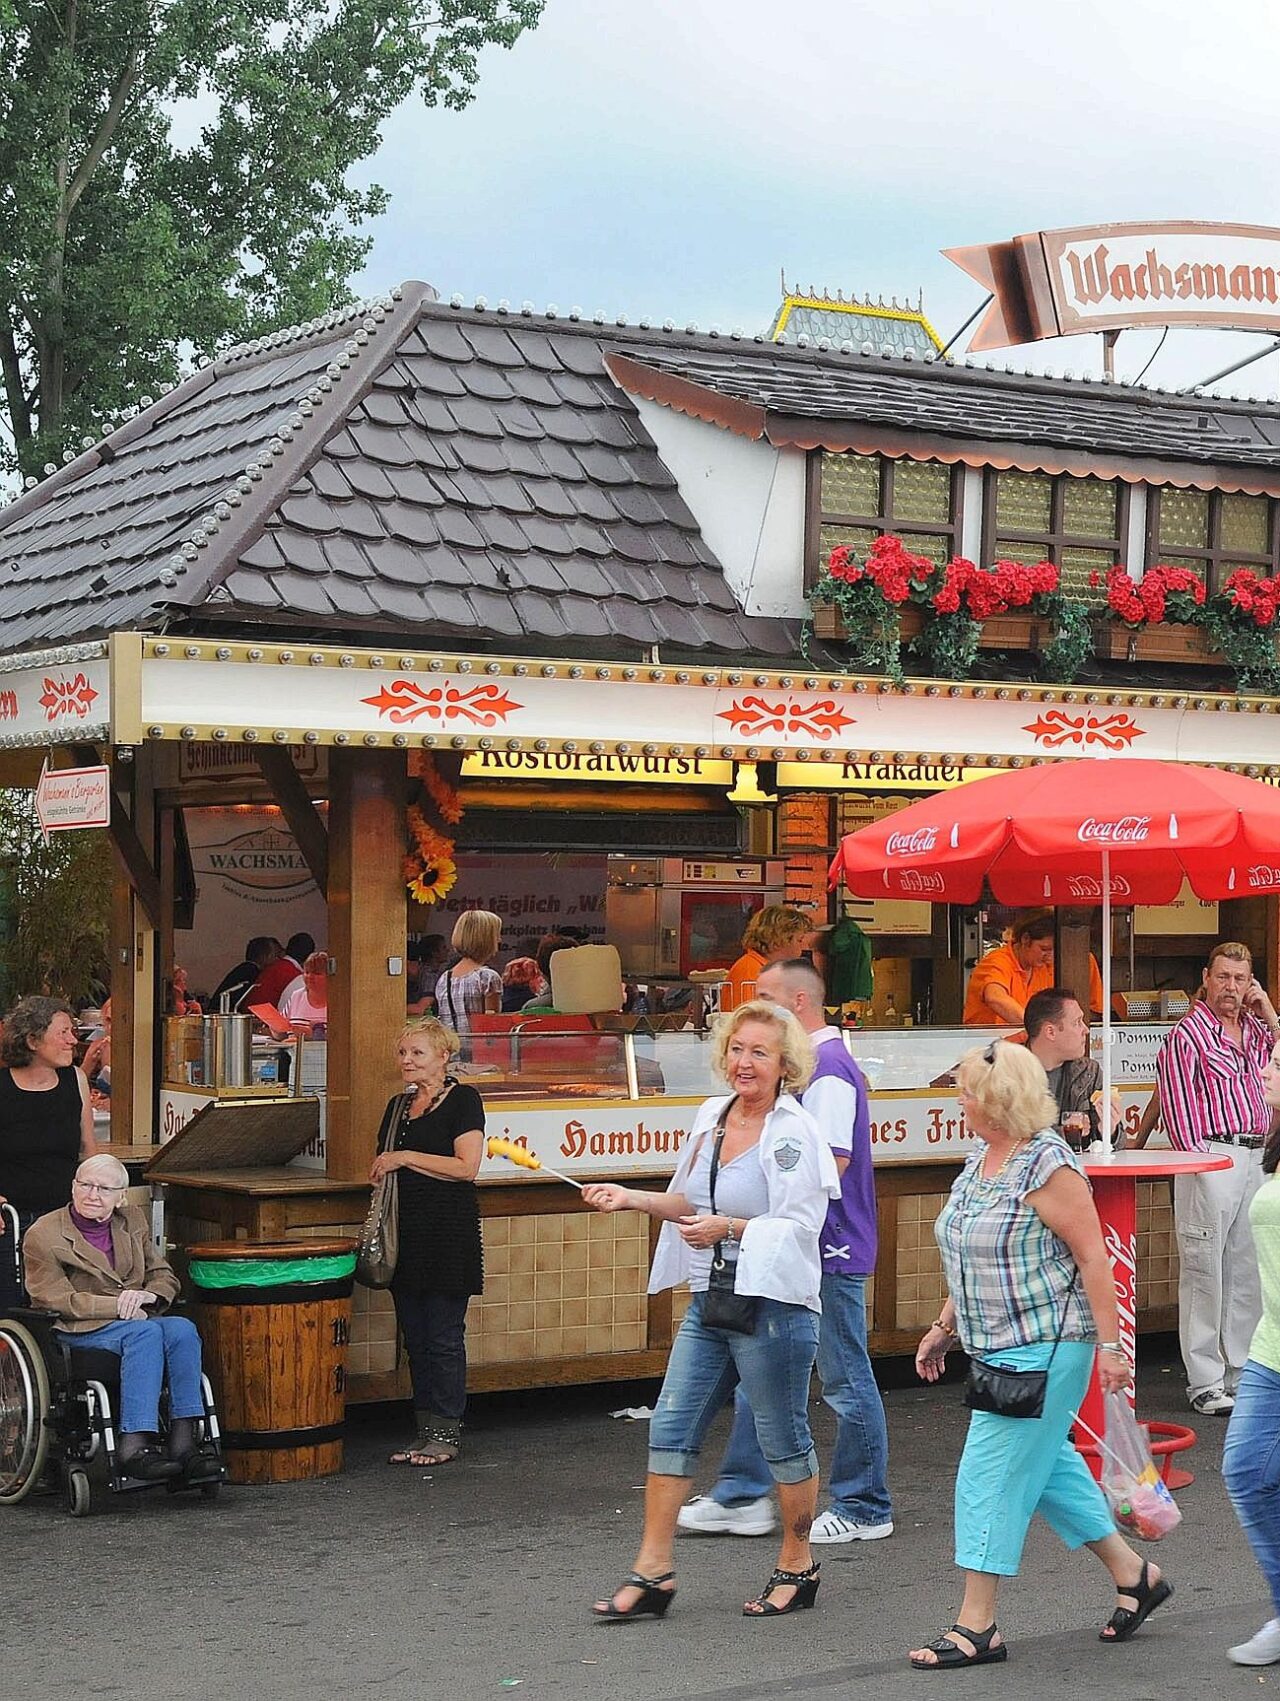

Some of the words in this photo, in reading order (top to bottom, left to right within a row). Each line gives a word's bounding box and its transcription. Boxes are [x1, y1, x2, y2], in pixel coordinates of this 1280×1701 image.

[886, 827, 939, 856] Coca-Cola
[1077, 816, 1151, 841] Coca-Cola
[560, 1119, 691, 1159] Hambur
